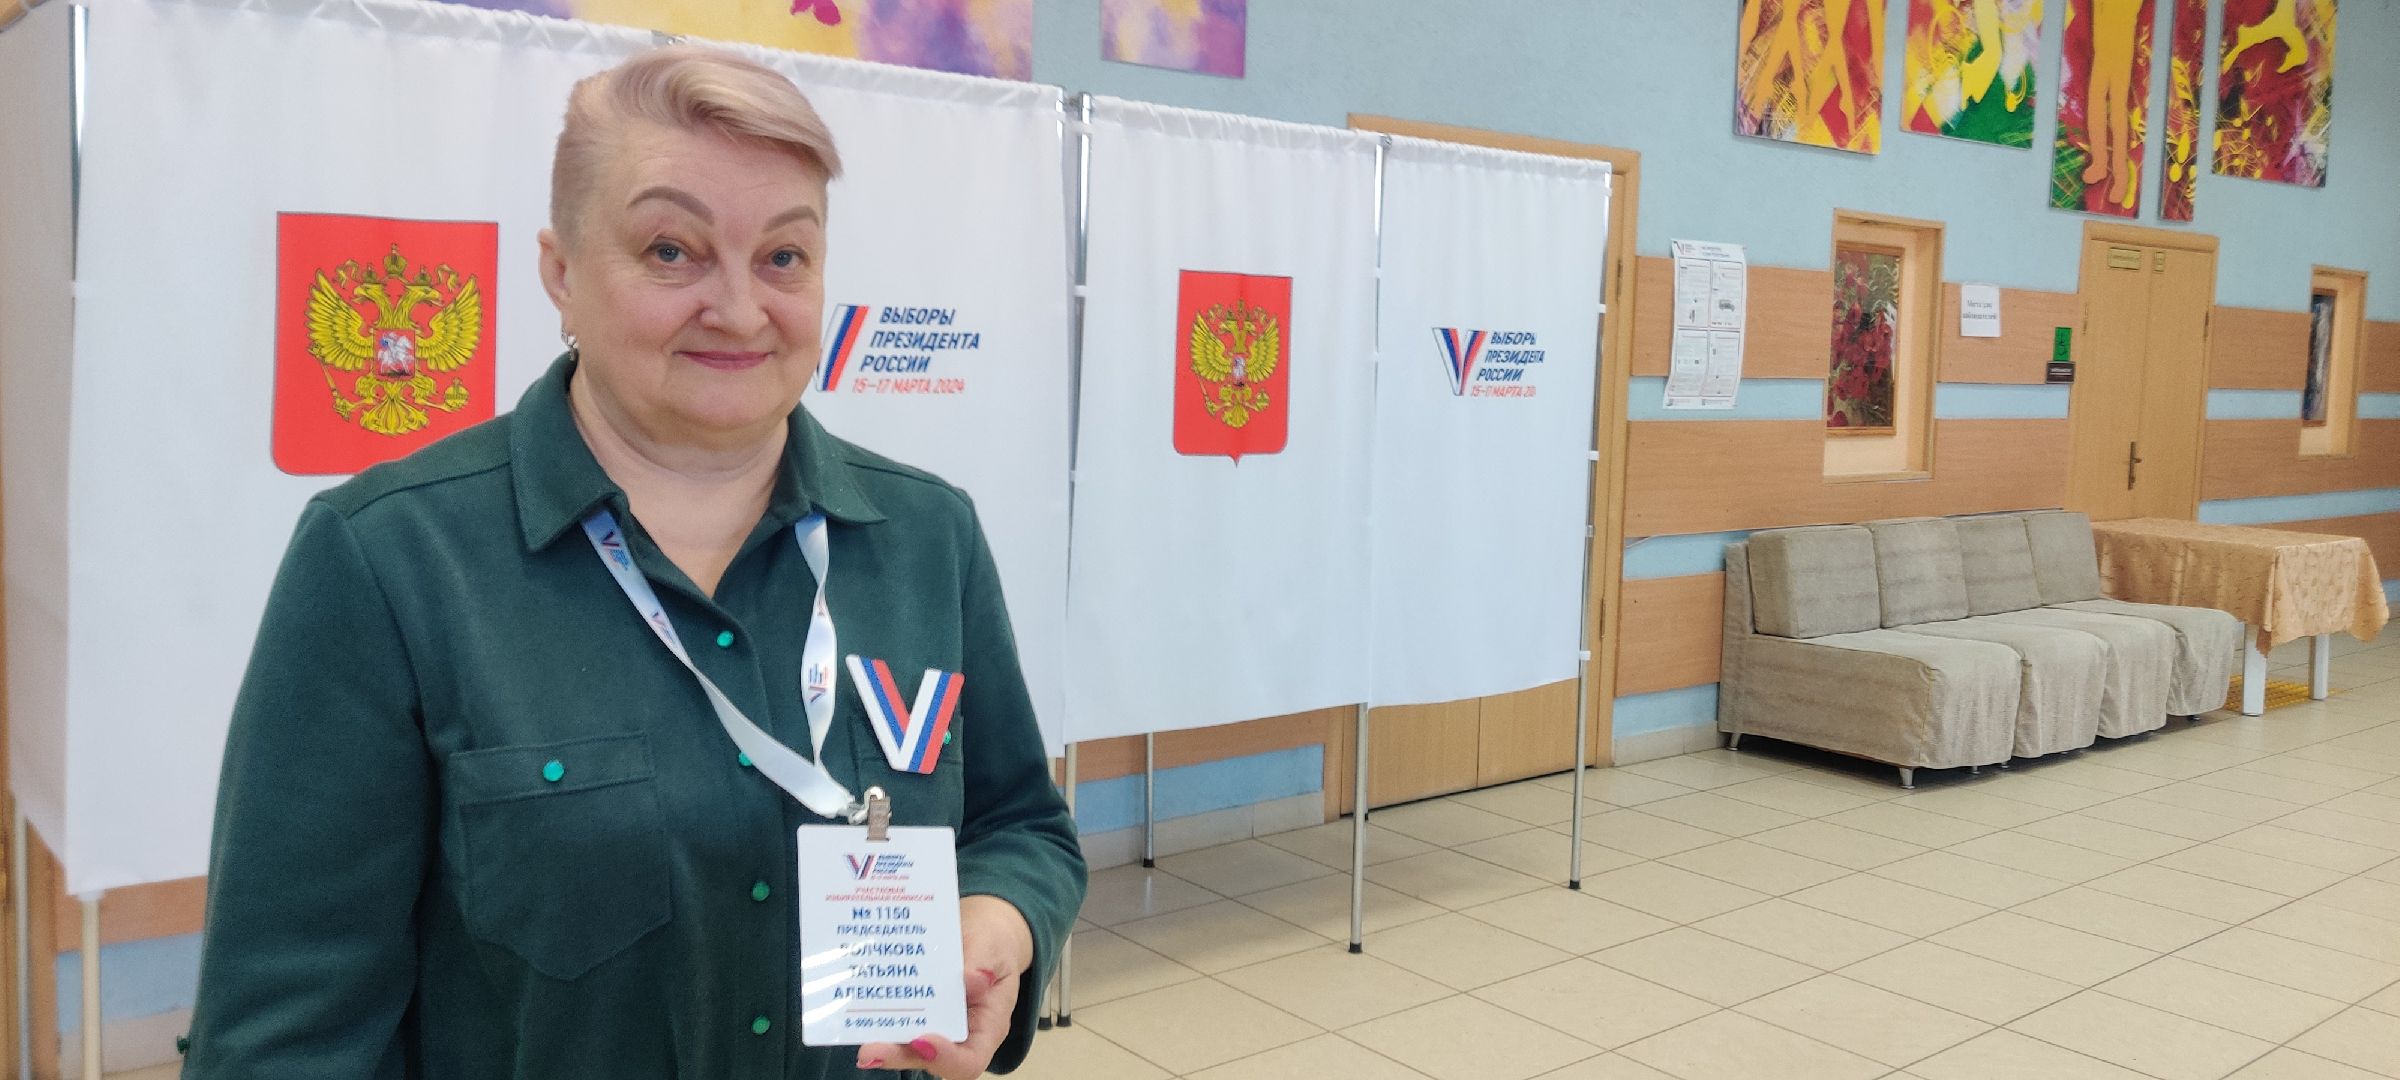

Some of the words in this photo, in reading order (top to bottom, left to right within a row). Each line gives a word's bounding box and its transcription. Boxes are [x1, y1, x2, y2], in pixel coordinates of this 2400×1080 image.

[879, 306, 956, 326] ВЫБОРЫ
[870, 330, 980, 351] ПРЕЗИДЕНТА
[860, 354, 931, 373] РОССИИ
[1476, 368, 1525, 382] РОССИИ
[892, 378, 931, 394] МАРТА
[852, 907, 871, 920] №
[836, 923, 927, 936] ПРЕДСЕДАТЕЛЬ
[833, 985, 936, 1000] АЛЕКСЕЕВНА
